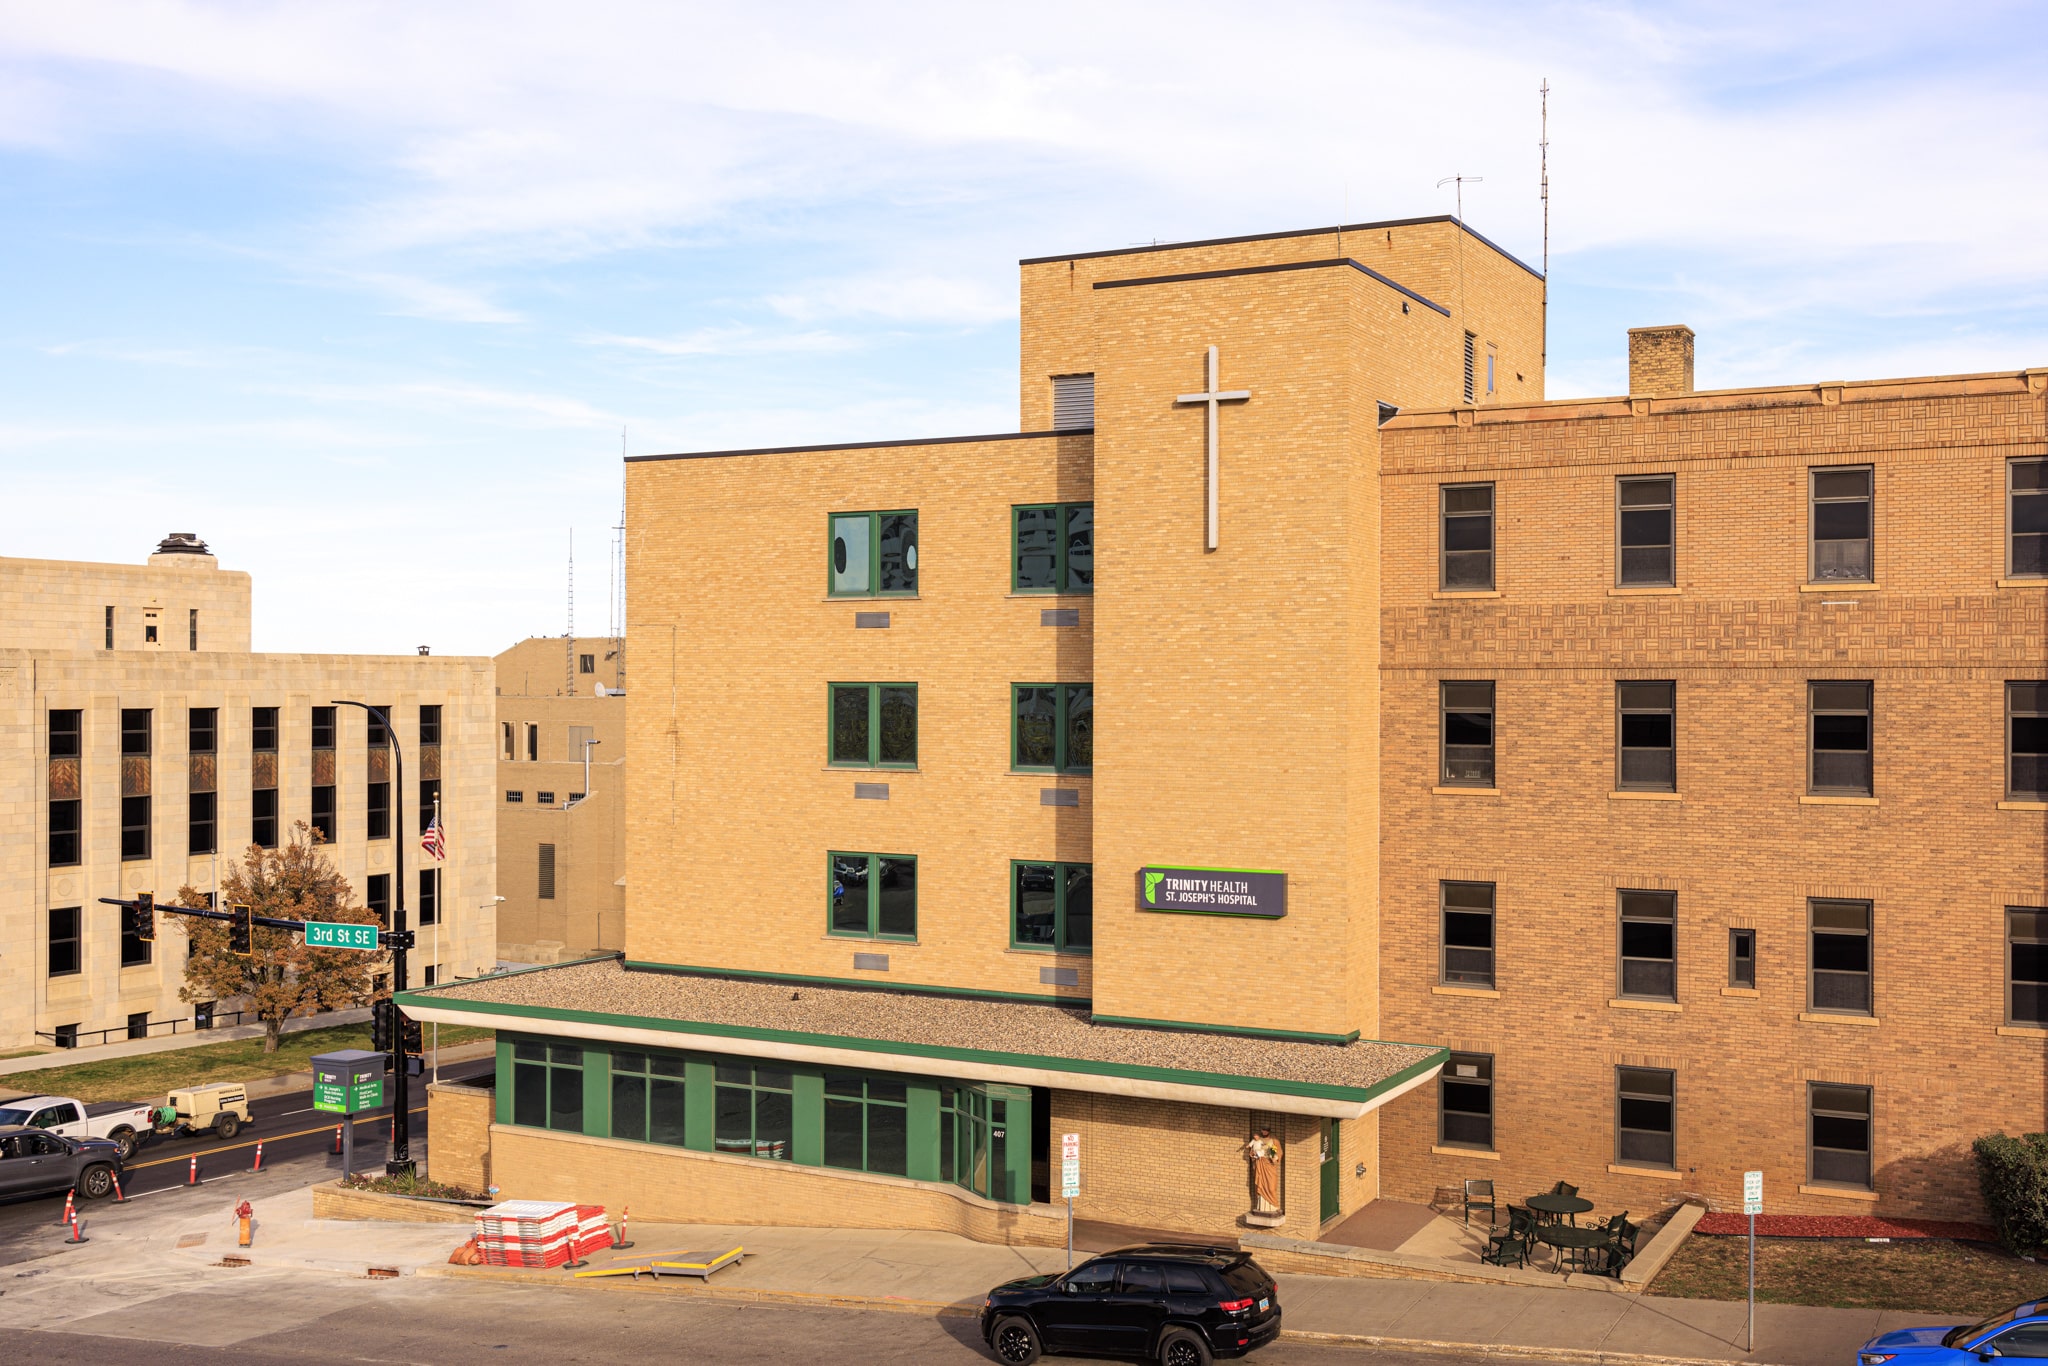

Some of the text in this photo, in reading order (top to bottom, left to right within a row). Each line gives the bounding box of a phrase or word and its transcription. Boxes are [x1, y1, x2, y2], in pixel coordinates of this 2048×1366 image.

[1166, 878, 1248, 894] TRINITY HEALTH
[1166, 892, 1258, 906] ST. JOSEPH'S HOSPITAL
[314, 928, 370, 944] 3rd St SE
